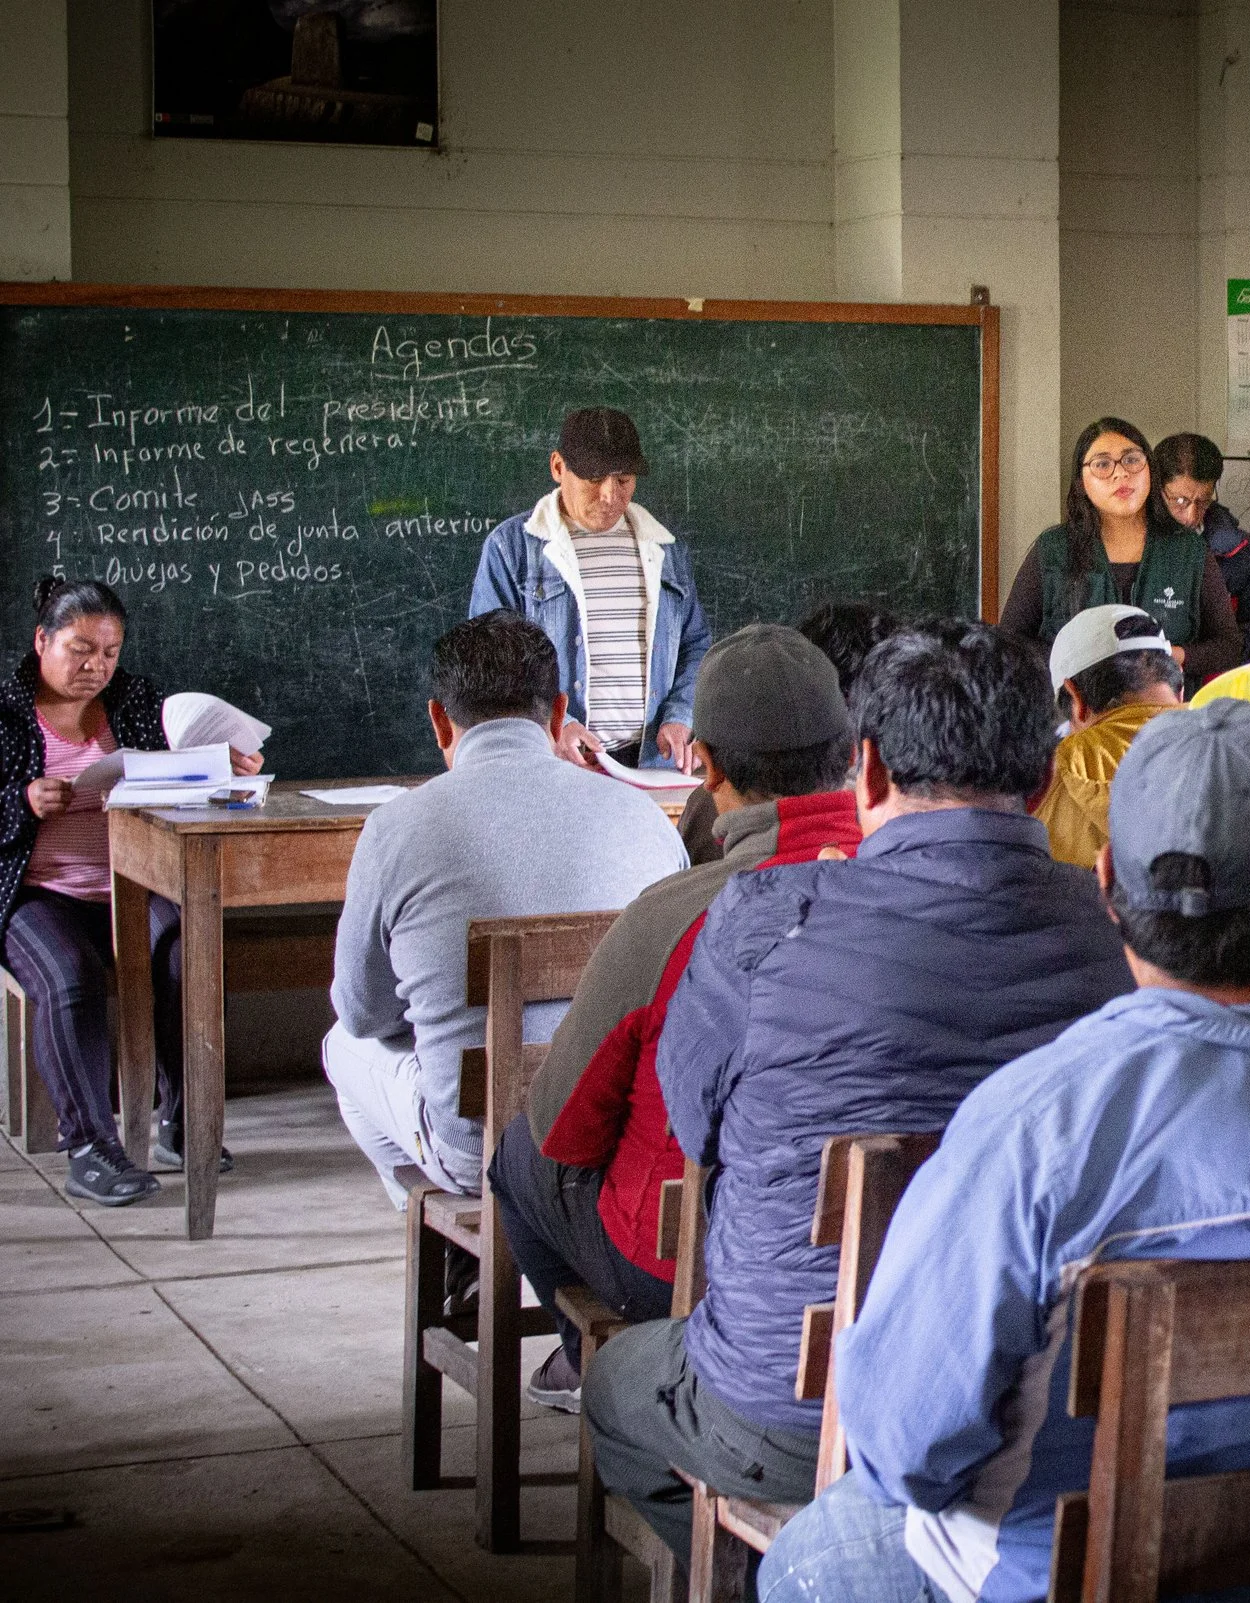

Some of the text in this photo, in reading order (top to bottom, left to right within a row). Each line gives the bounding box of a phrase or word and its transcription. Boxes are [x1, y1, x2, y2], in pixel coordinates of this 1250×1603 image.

[372, 316, 537, 380] Agendas
[87, 394, 218, 446] Informe
[235, 373, 287, 423] del
[323, 380, 493, 437] presidente
[94, 443, 206, 475] Informe
[218, 423, 248, 454] de
[98, 513, 228, 547] Rendición
[250, 514, 277, 542] de
[287, 508, 360, 557] junta
[385, 497, 498, 538] anterior
[208, 563, 221, 595] y
